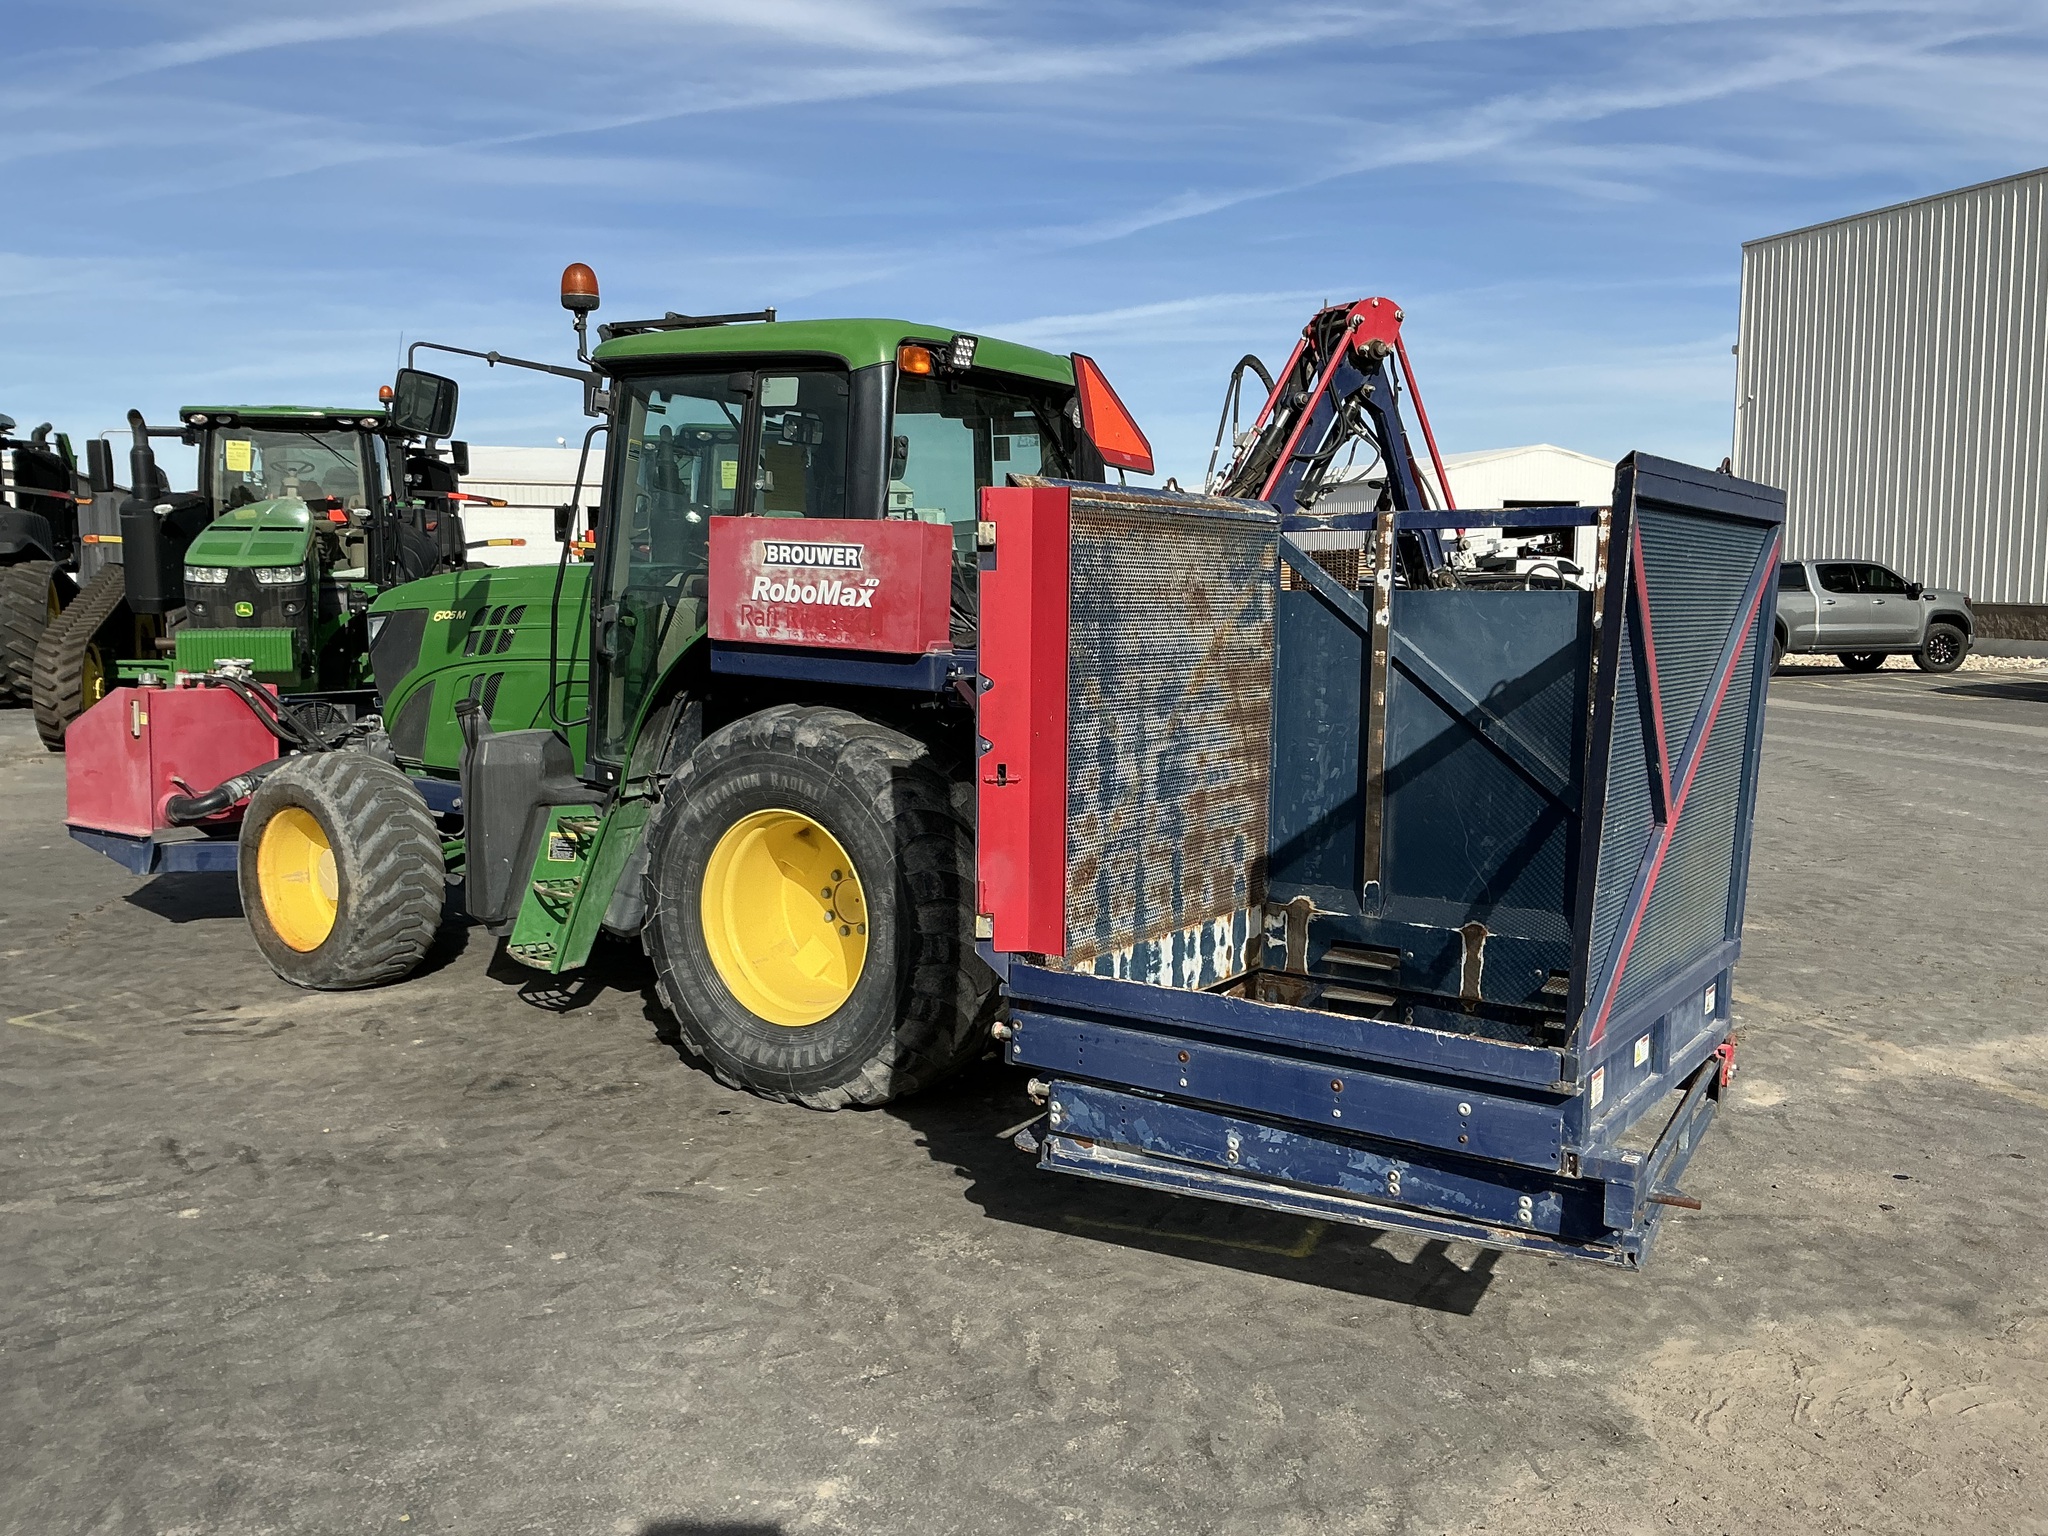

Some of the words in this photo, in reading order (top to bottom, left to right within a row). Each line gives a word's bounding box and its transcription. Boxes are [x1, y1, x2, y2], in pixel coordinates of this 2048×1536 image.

[766, 544, 858, 567] BROUWER
[751, 576, 875, 608] RoboMax
[860, 578, 881, 587] JD
[741, 604, 779, 628] Raft
[770, 771, 819, 801] RADIAL
[711, 1016, 835, 1069] ALLIANCE
